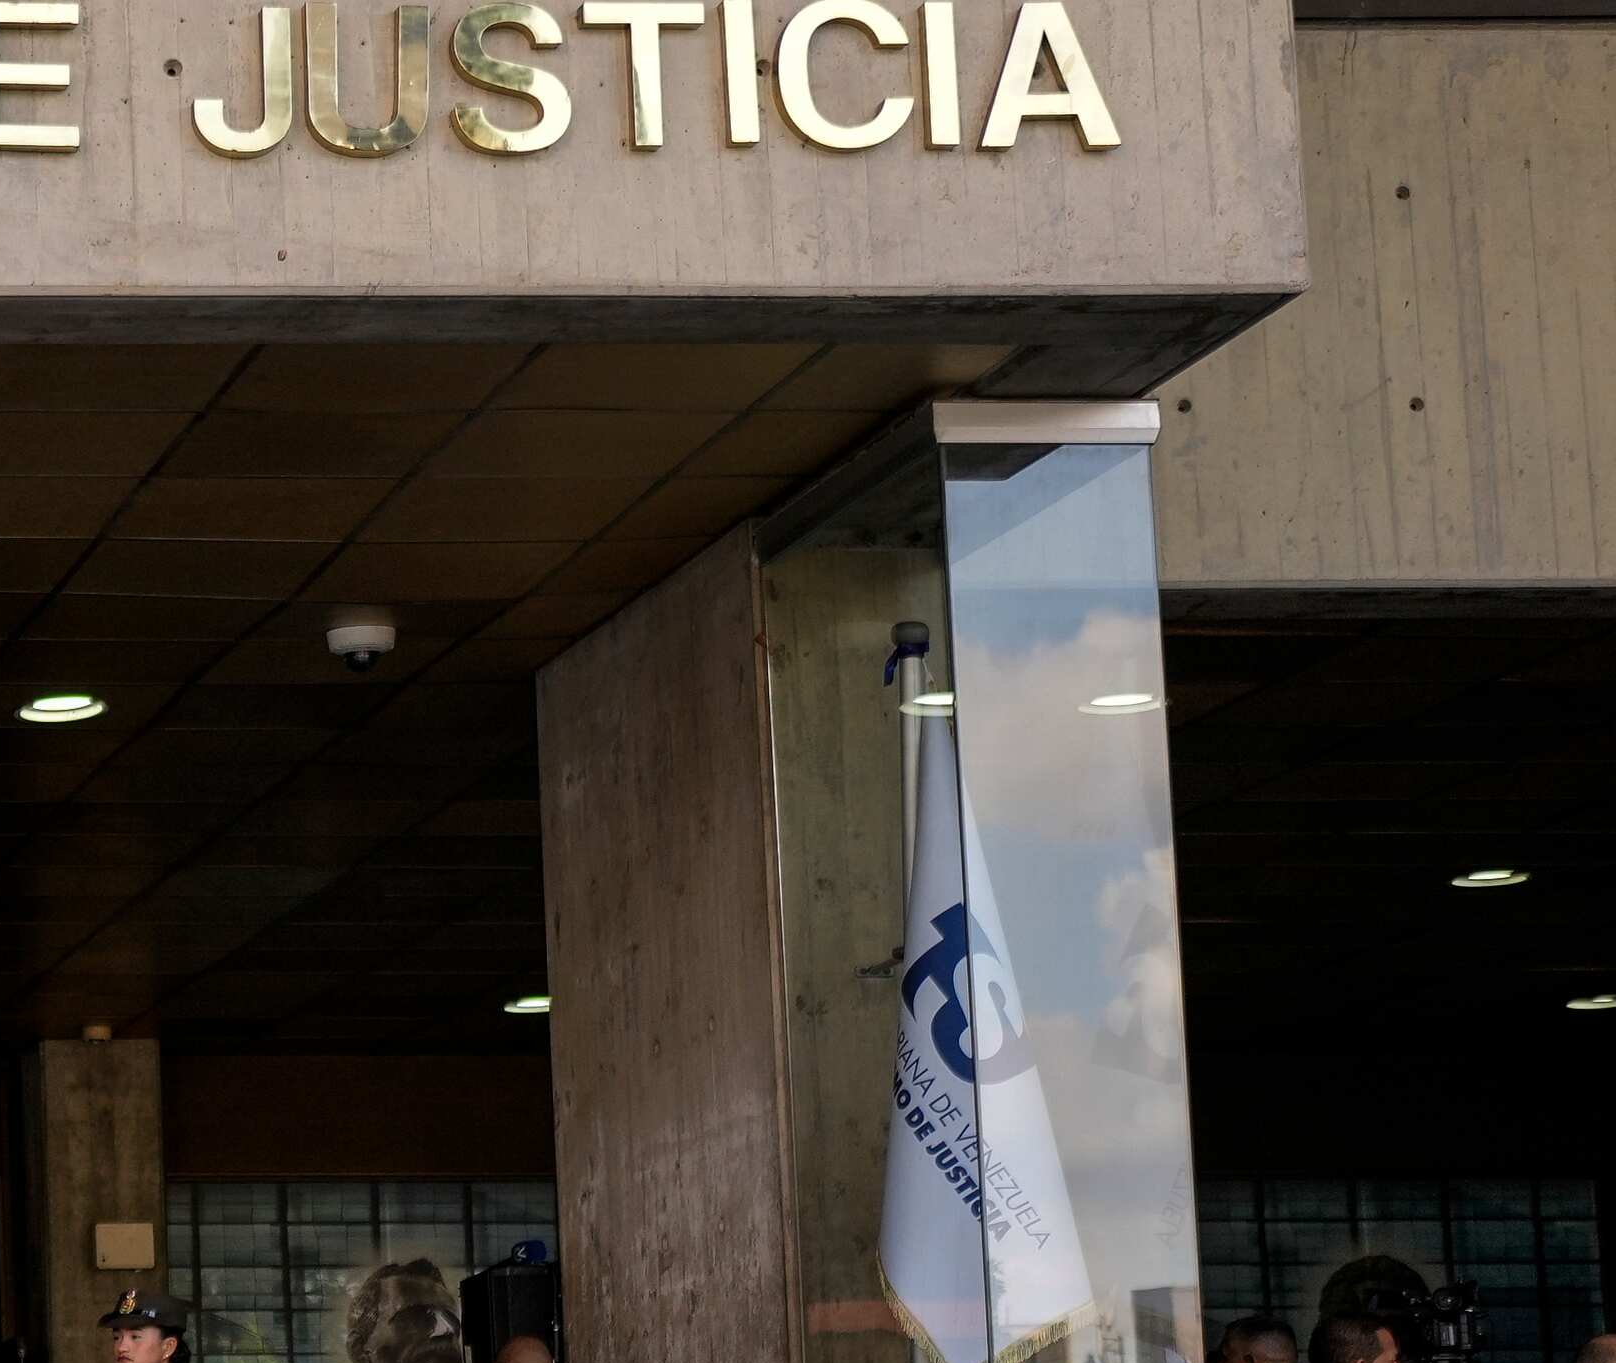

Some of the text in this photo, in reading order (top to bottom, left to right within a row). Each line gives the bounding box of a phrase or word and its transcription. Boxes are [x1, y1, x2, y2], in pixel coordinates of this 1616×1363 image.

[190, 0, 1123, 160] JUSTICIA
[905, 1106, 936, 1143] DE
[926, 1141, 1012, 1243] JUSTICIA
[929, 1093, 962, 1128] DE
[955, 1124, 1050, 1250] VENEZUELA
